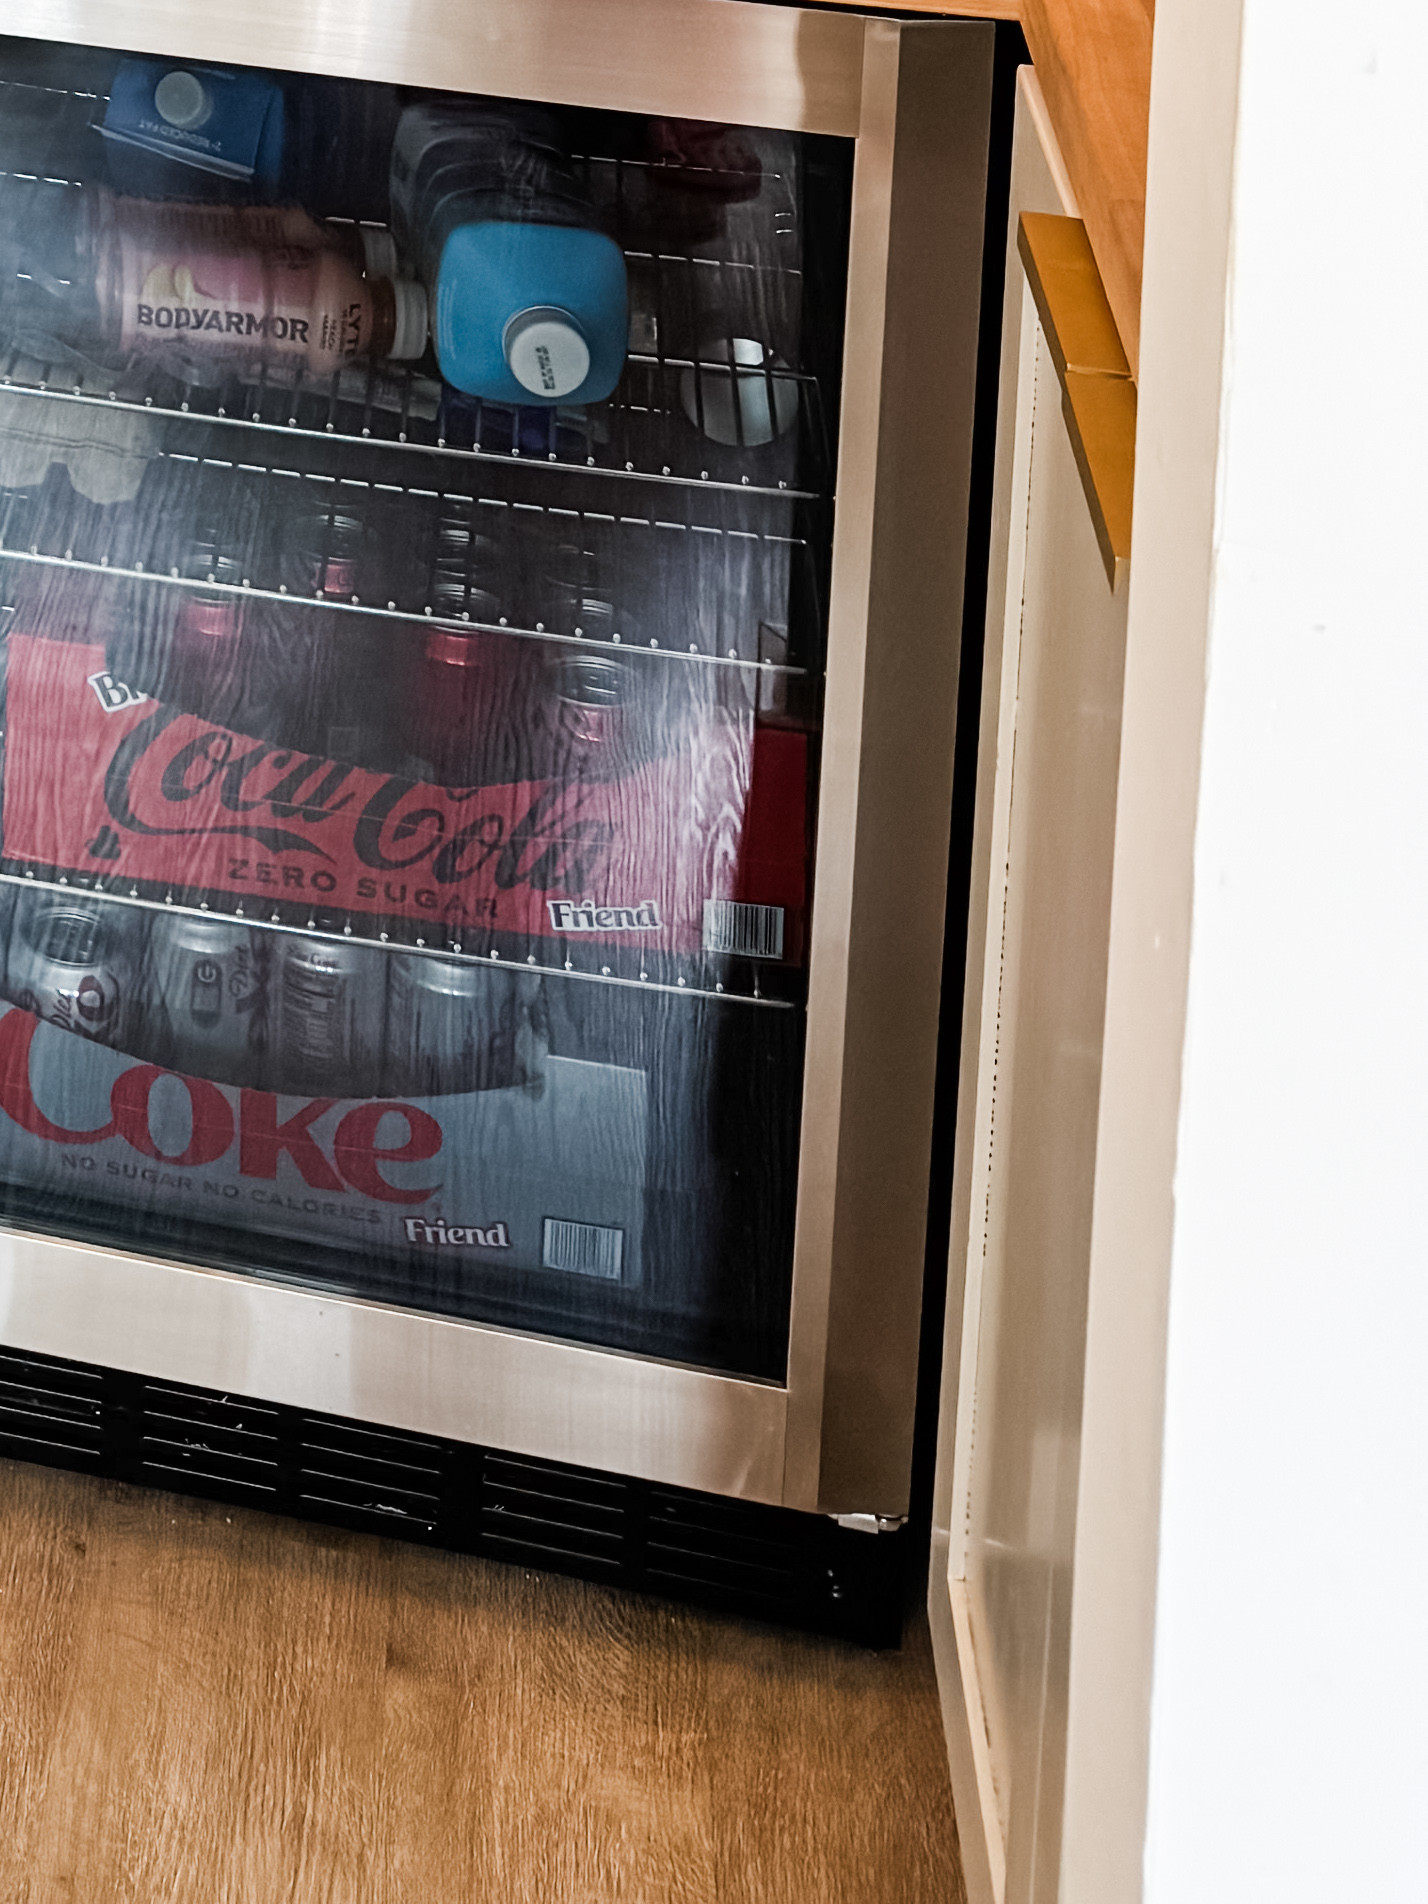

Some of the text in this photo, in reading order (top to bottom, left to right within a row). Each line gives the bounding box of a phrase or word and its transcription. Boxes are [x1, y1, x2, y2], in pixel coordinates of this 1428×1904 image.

[136, 302, 310, 344] BODYARMOR
[227, 857, 498, 920] ZERO SUGAR
[548, 899, 660, 930] Friend
[60, 1153, 382, 1226] NO SUGAR NO CALORIES
[403, 1217, 511, 1249] Friend
